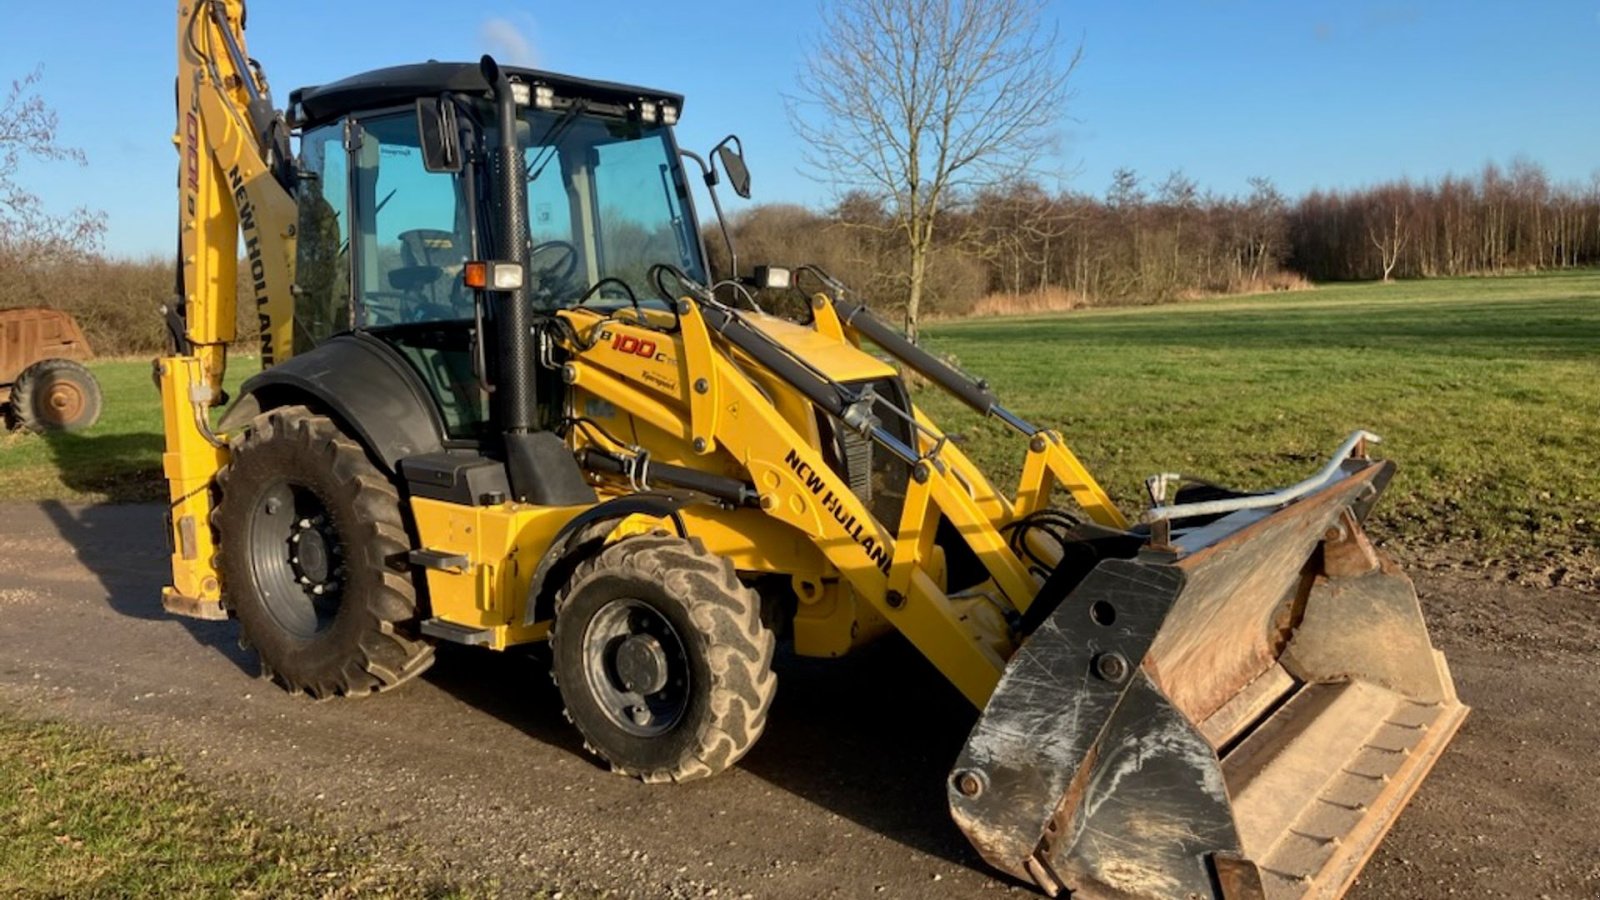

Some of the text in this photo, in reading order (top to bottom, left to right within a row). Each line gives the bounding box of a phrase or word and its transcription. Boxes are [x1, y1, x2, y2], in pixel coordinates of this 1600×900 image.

[187, 112, 199, 193] 100
[227, 166, 255, 230] NEW
[601, 331, 612, 340] B
[612, 334, 656, 358] 100
[655, 353, 667, 362] C
[784, 448, 825, 495] NEW
